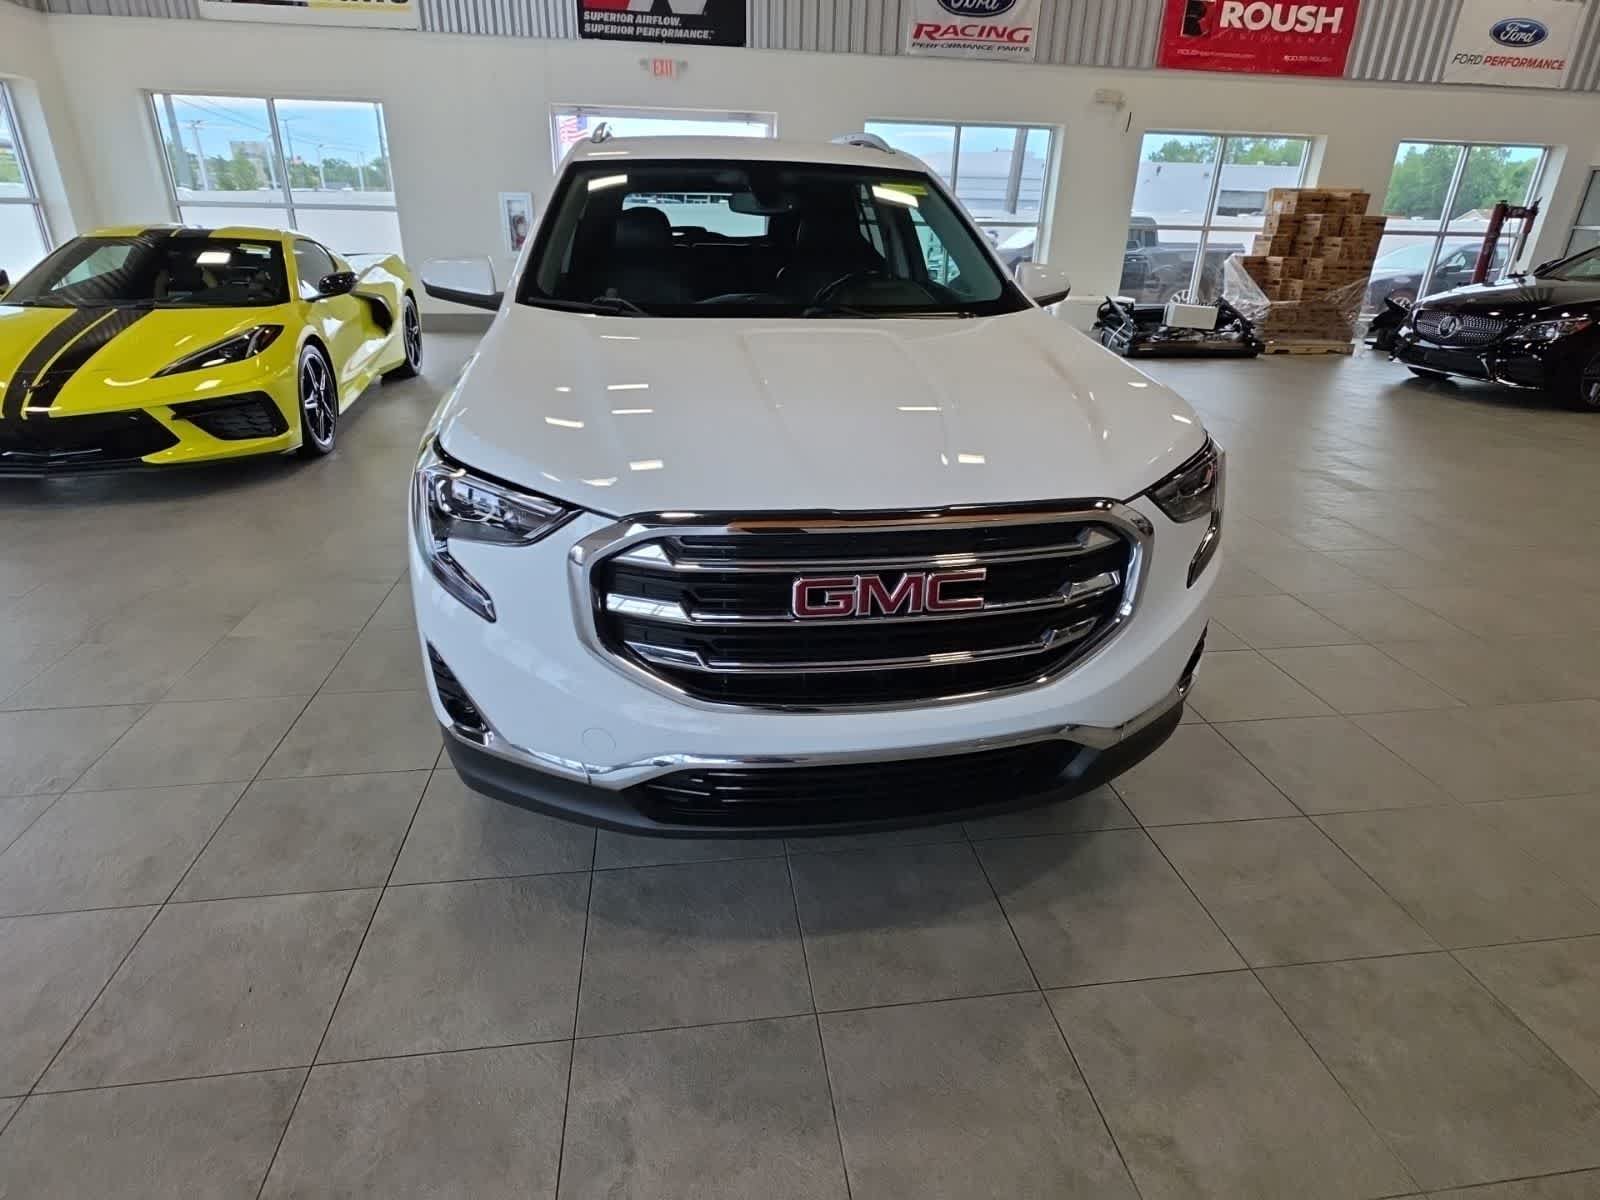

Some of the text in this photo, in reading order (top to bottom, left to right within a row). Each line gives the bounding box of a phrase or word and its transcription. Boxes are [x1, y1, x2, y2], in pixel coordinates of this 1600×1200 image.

[583, 11, 682, 27] SUPERIOR AIRFLOW.
[1219, 1, 1344, 34] ROUSH
[583, 23, 635, 36] SUPERIOR
[912, 23, 1033, 43] RACING
[1500, 22, 1538, 43] Ford
[912, 42, 993, 51] PERFORMANCE
[1452, 53, 1567, 70] FORD PERFORMANCE
[792, 567, 987, 618] GMC
